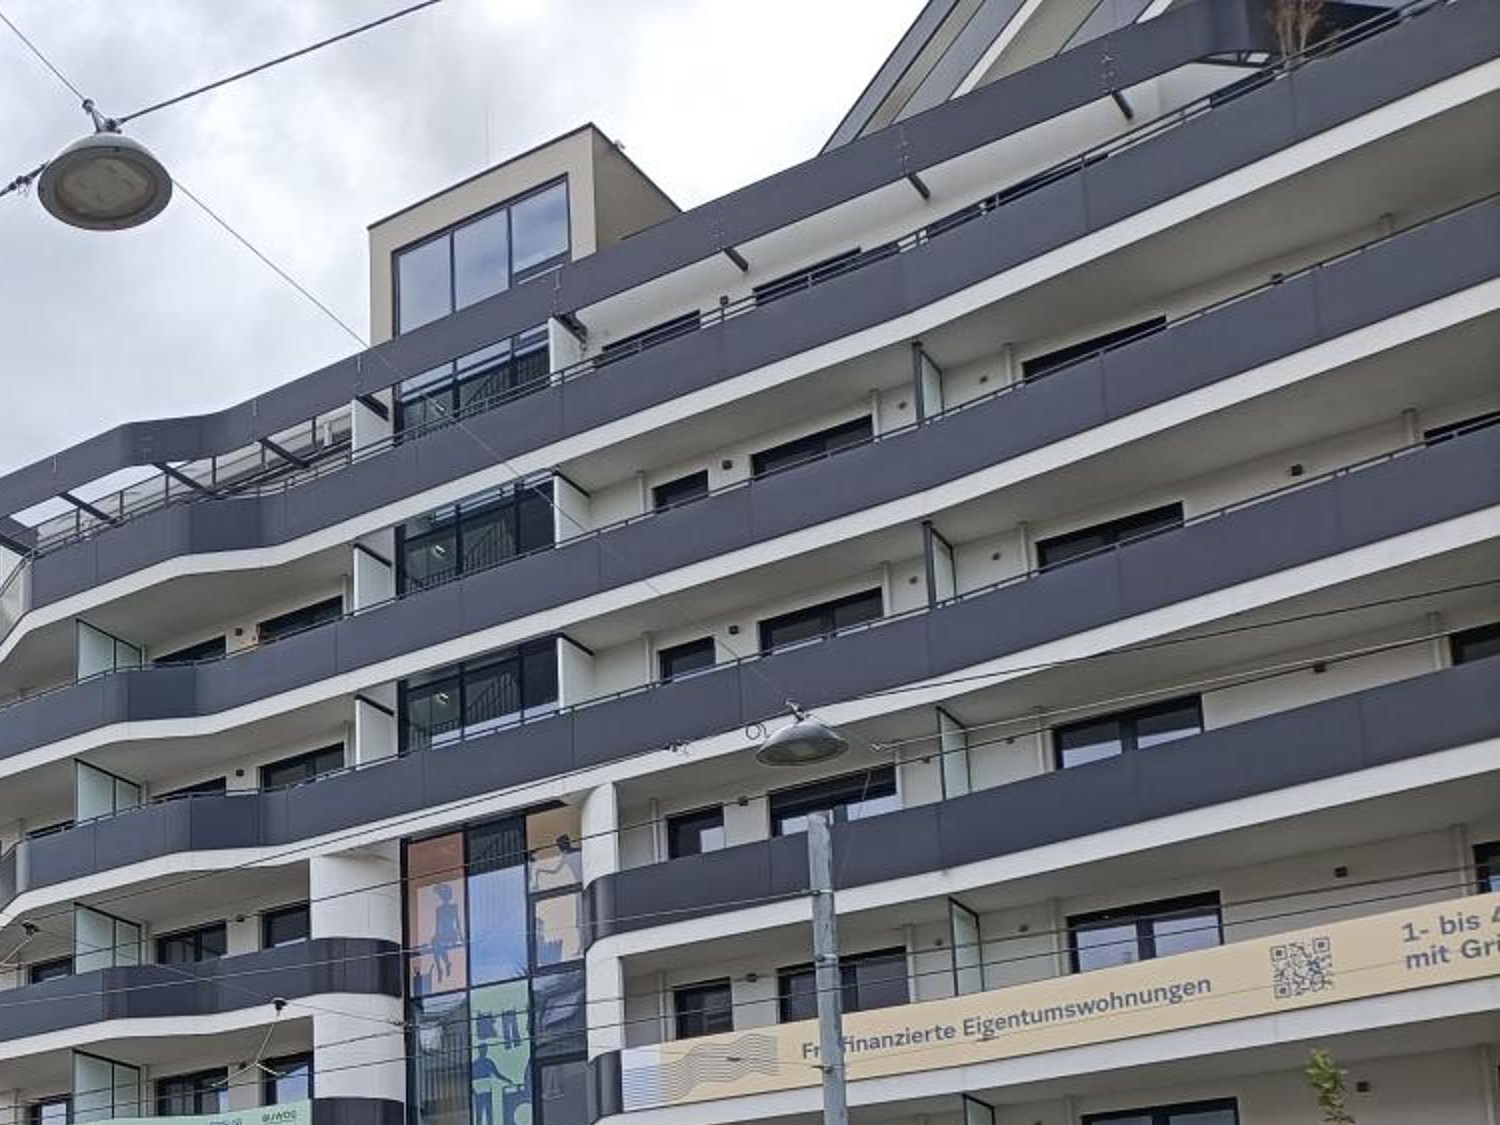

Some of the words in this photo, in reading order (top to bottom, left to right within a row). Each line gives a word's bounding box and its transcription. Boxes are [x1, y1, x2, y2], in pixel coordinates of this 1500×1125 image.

[1403, 922, 1429, 943] 1-
[1440, 911, 1481, 935] bis
[1406, 944, 1452, 970] mit
[1460, 933, 1500, 960] Gr
[963, 976, 1212, 1038] Eigentumswohnungen
